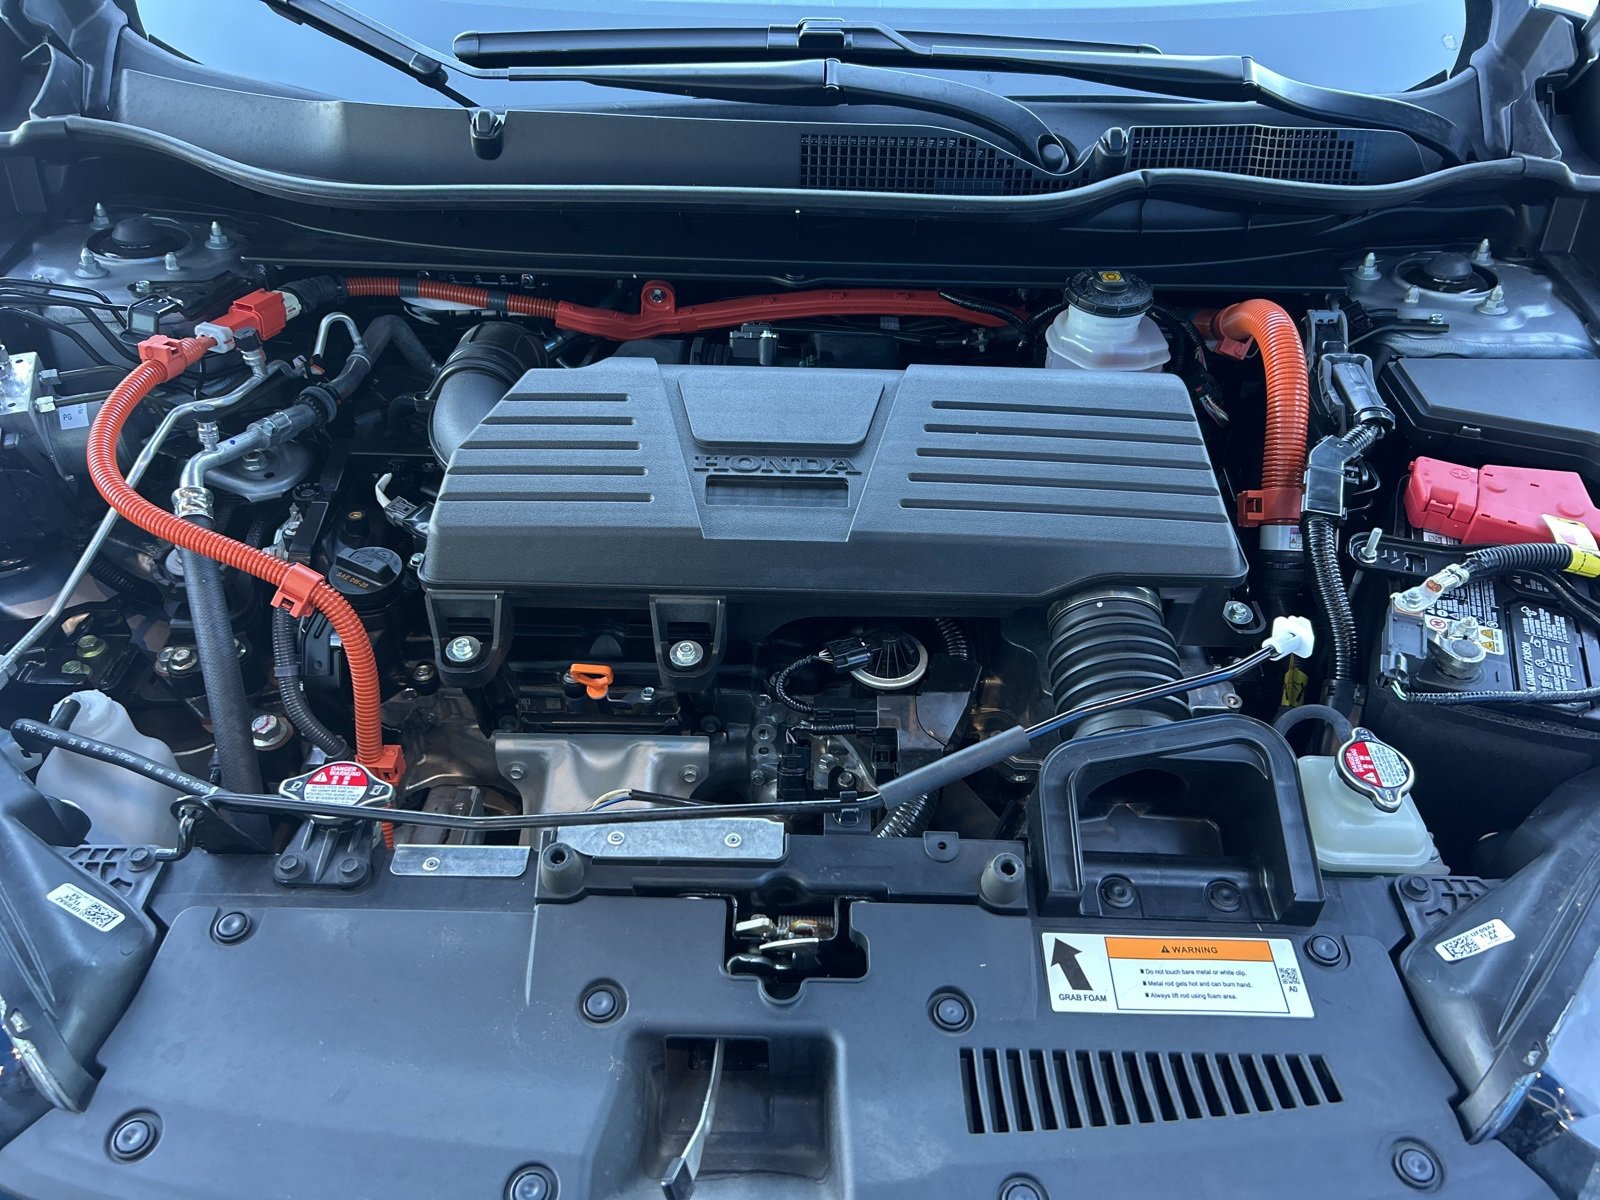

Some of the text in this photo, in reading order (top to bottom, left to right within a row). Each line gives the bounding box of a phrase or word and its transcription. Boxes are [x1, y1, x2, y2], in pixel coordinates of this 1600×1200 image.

[694, 455, 862, 475] HONDA
[336, 572, 369, 589] SAE 0W-20
[24, 724, 36, 733] TPC
[102, 747, 115, 756] TPC
[176, 775, 190, 784] TPC
[1235, 970, 1247, 978] clip.
[1058, 993, 1107, 1002] GRAB FOAM
